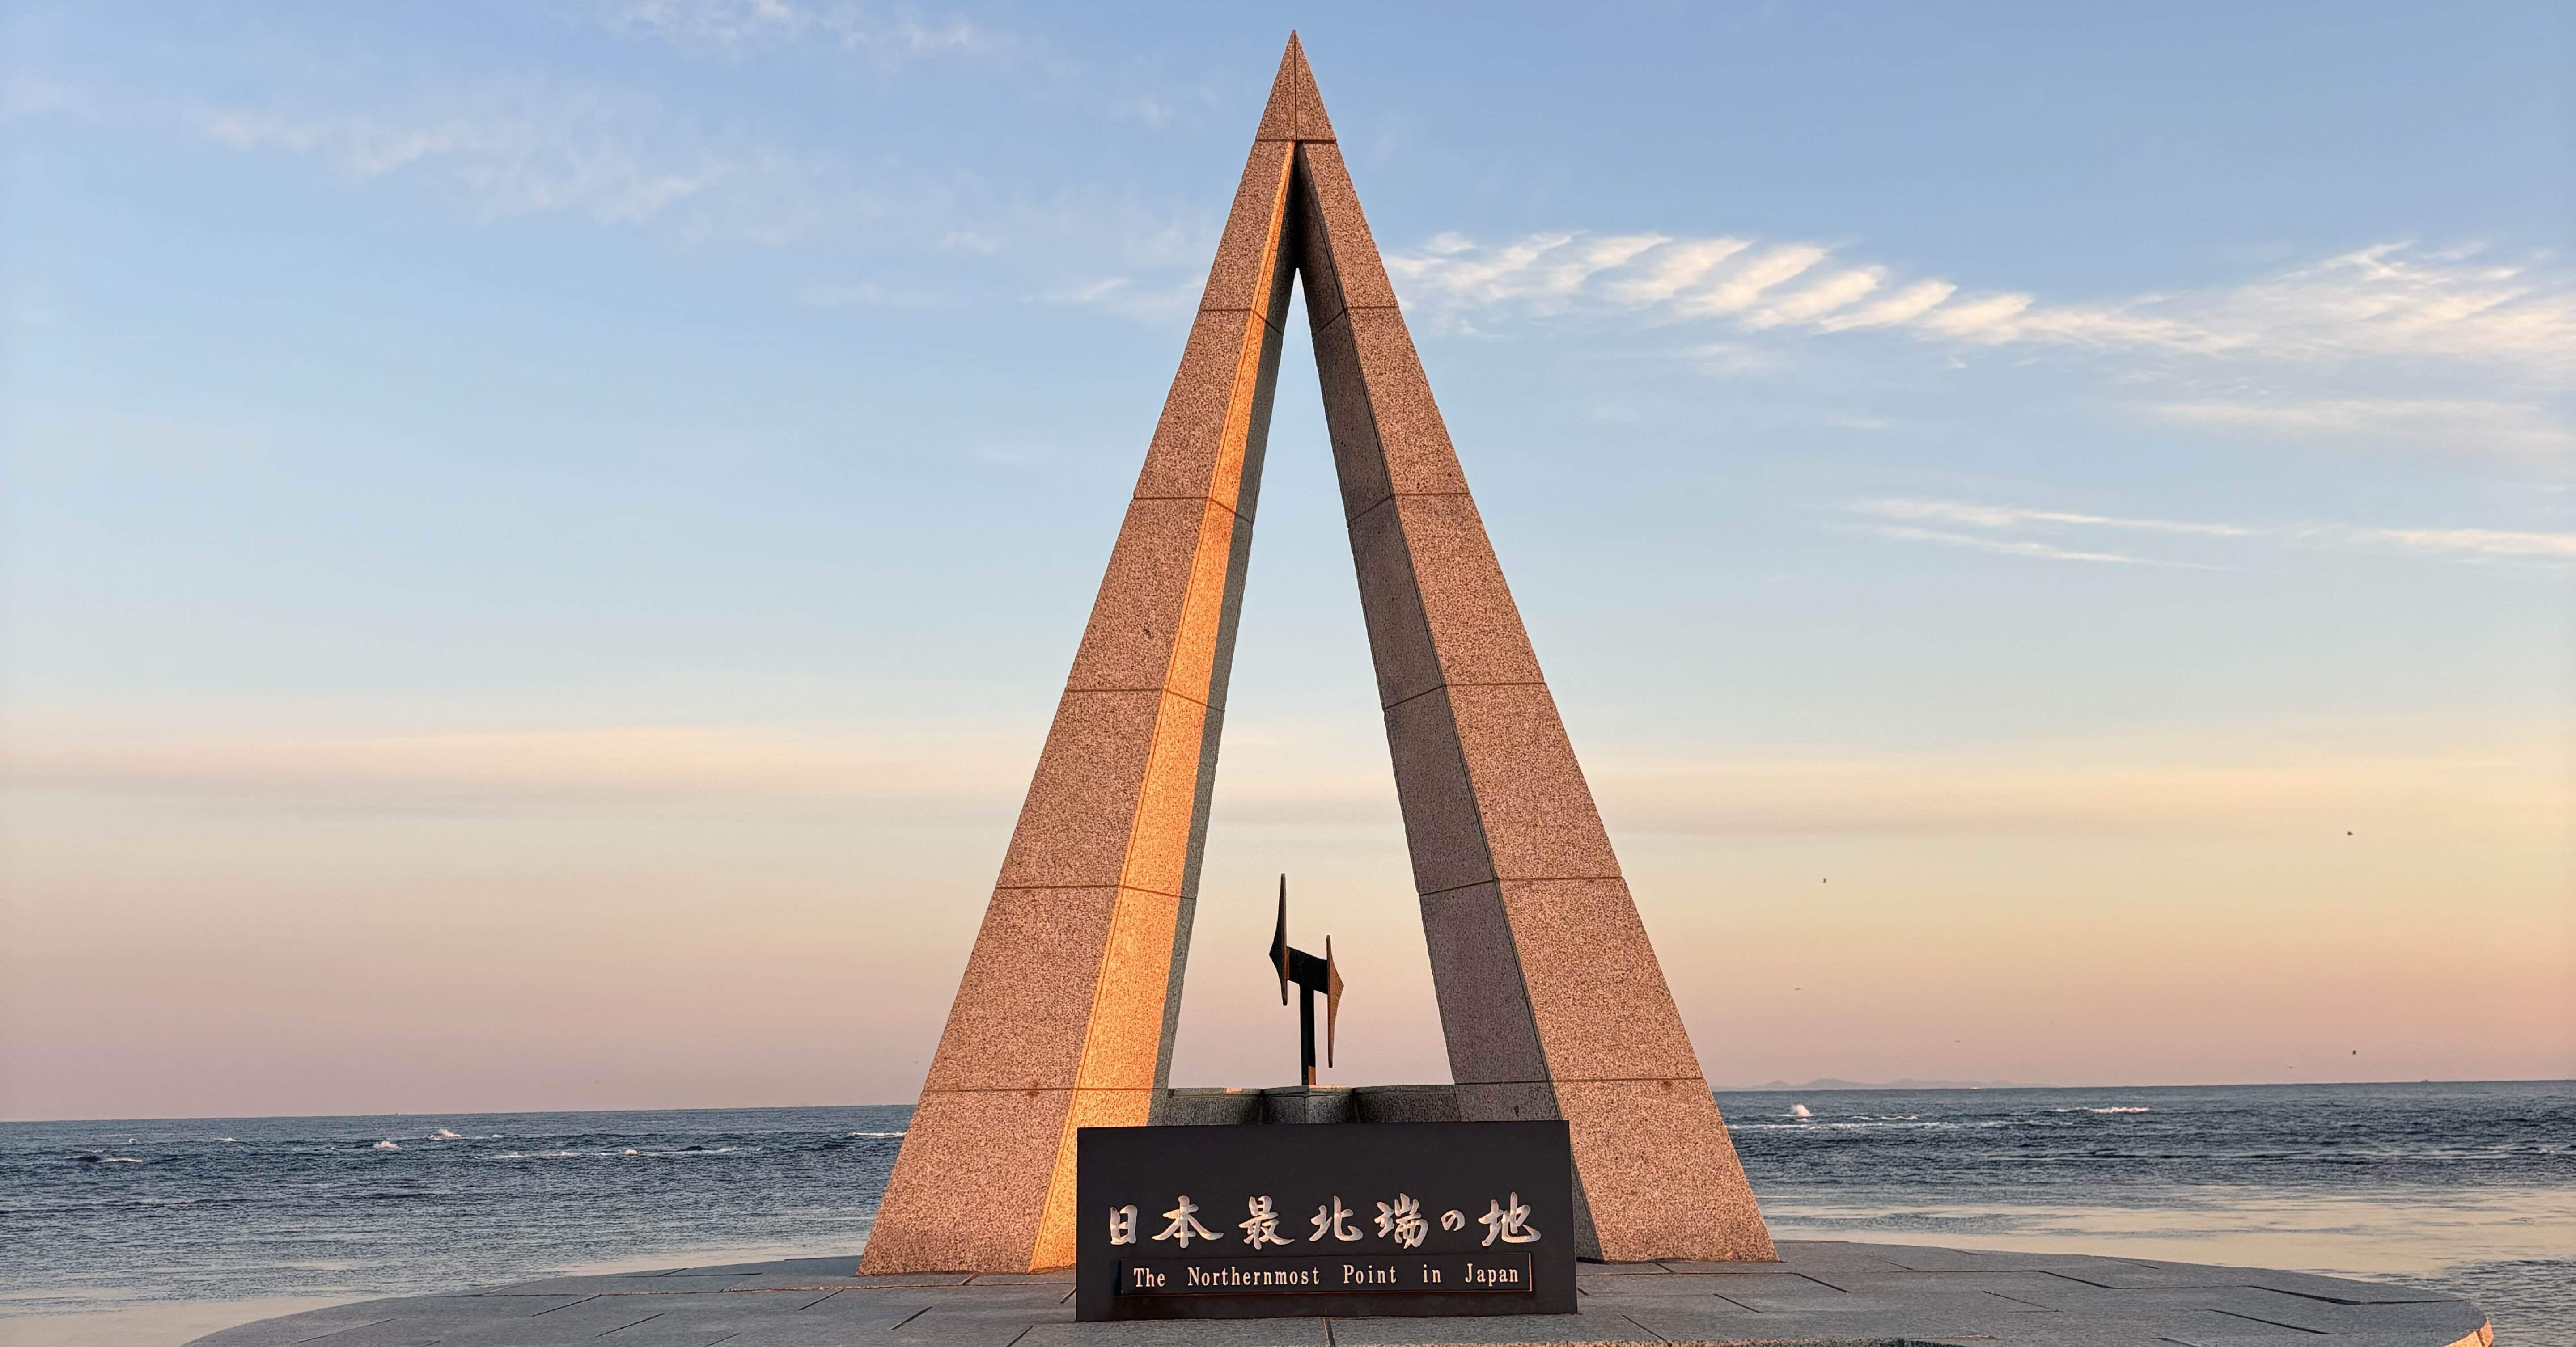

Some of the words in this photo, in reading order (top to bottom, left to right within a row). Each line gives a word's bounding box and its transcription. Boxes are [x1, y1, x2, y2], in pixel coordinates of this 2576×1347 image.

[1110, 1191, 1541, 1250] 日本最北端の地
[1134, 1267, 1165, 1287] The
[1187, 1266, 1320, 1286] Northernmost
[1343, 1264, 1397, 1284] Point
[1423, 1264, 1441, 1283] in
[1465, 1263, 1518, 1287] Japan
